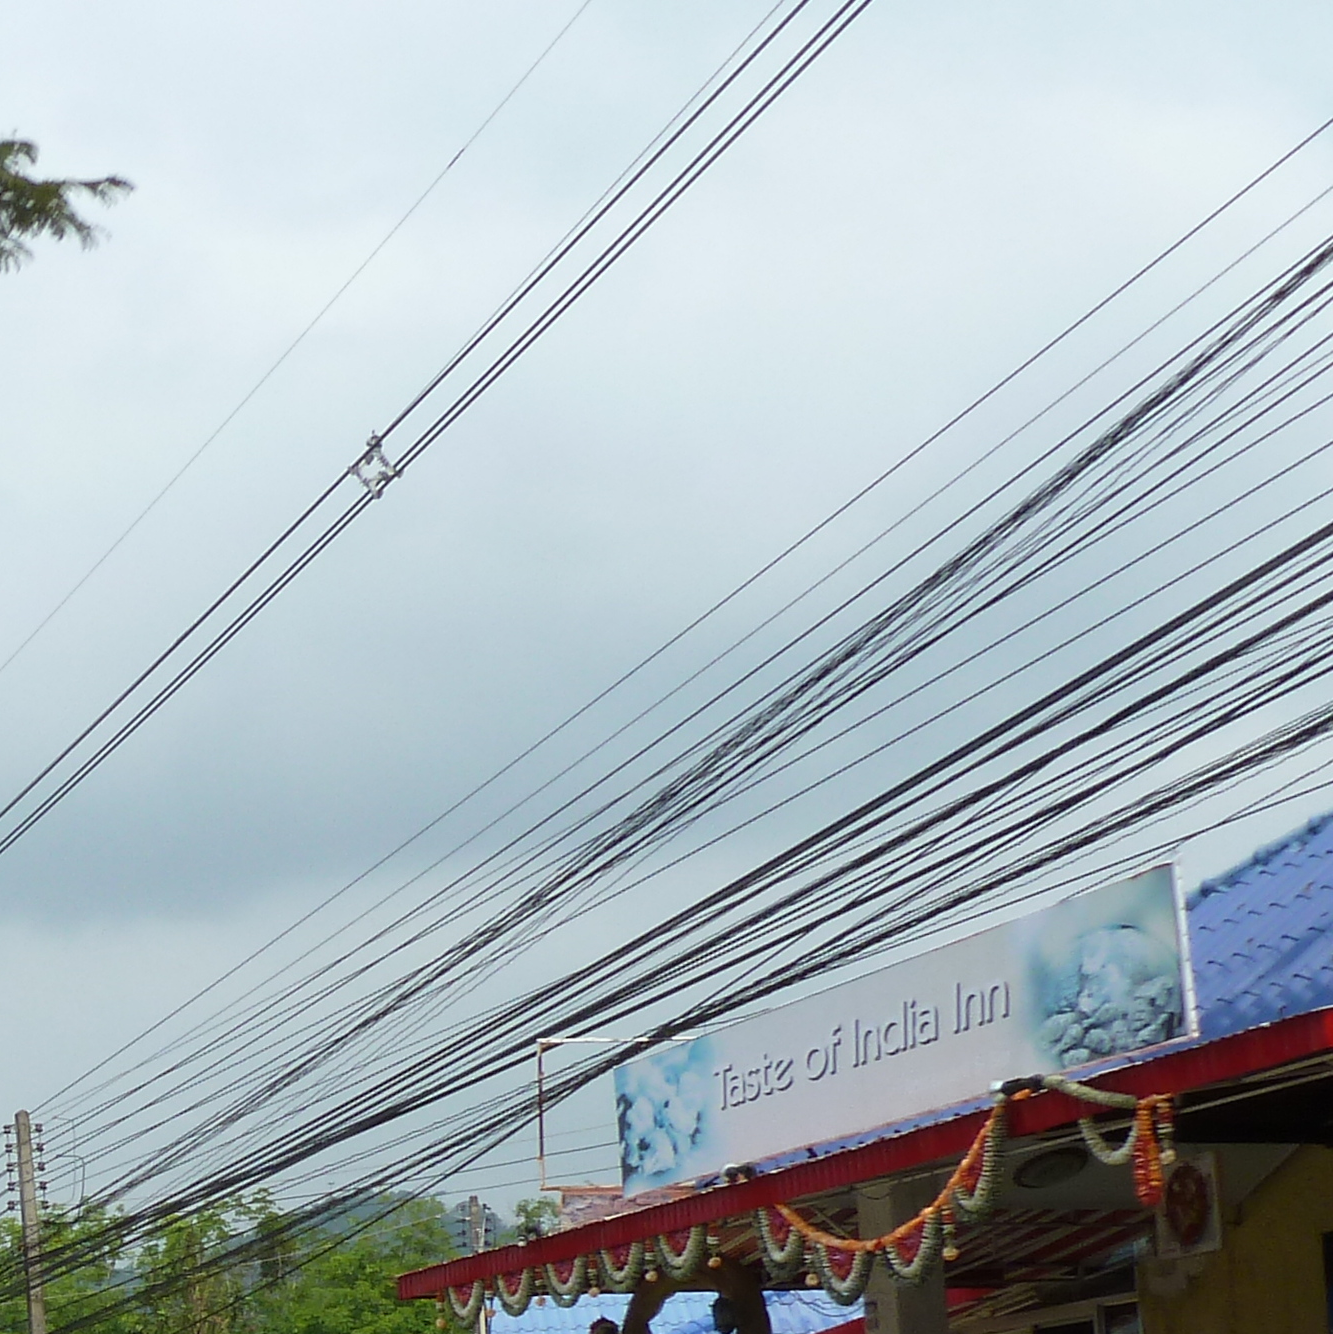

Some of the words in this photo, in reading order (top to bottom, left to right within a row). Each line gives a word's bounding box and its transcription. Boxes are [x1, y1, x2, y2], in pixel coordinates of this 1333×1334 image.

[713, 1053, 794, 1111] Taste
[806, 1024, 842, 1081] of
[852, 1000, 940, 1068] India
[953, 982, 1011, 1034] Inn
